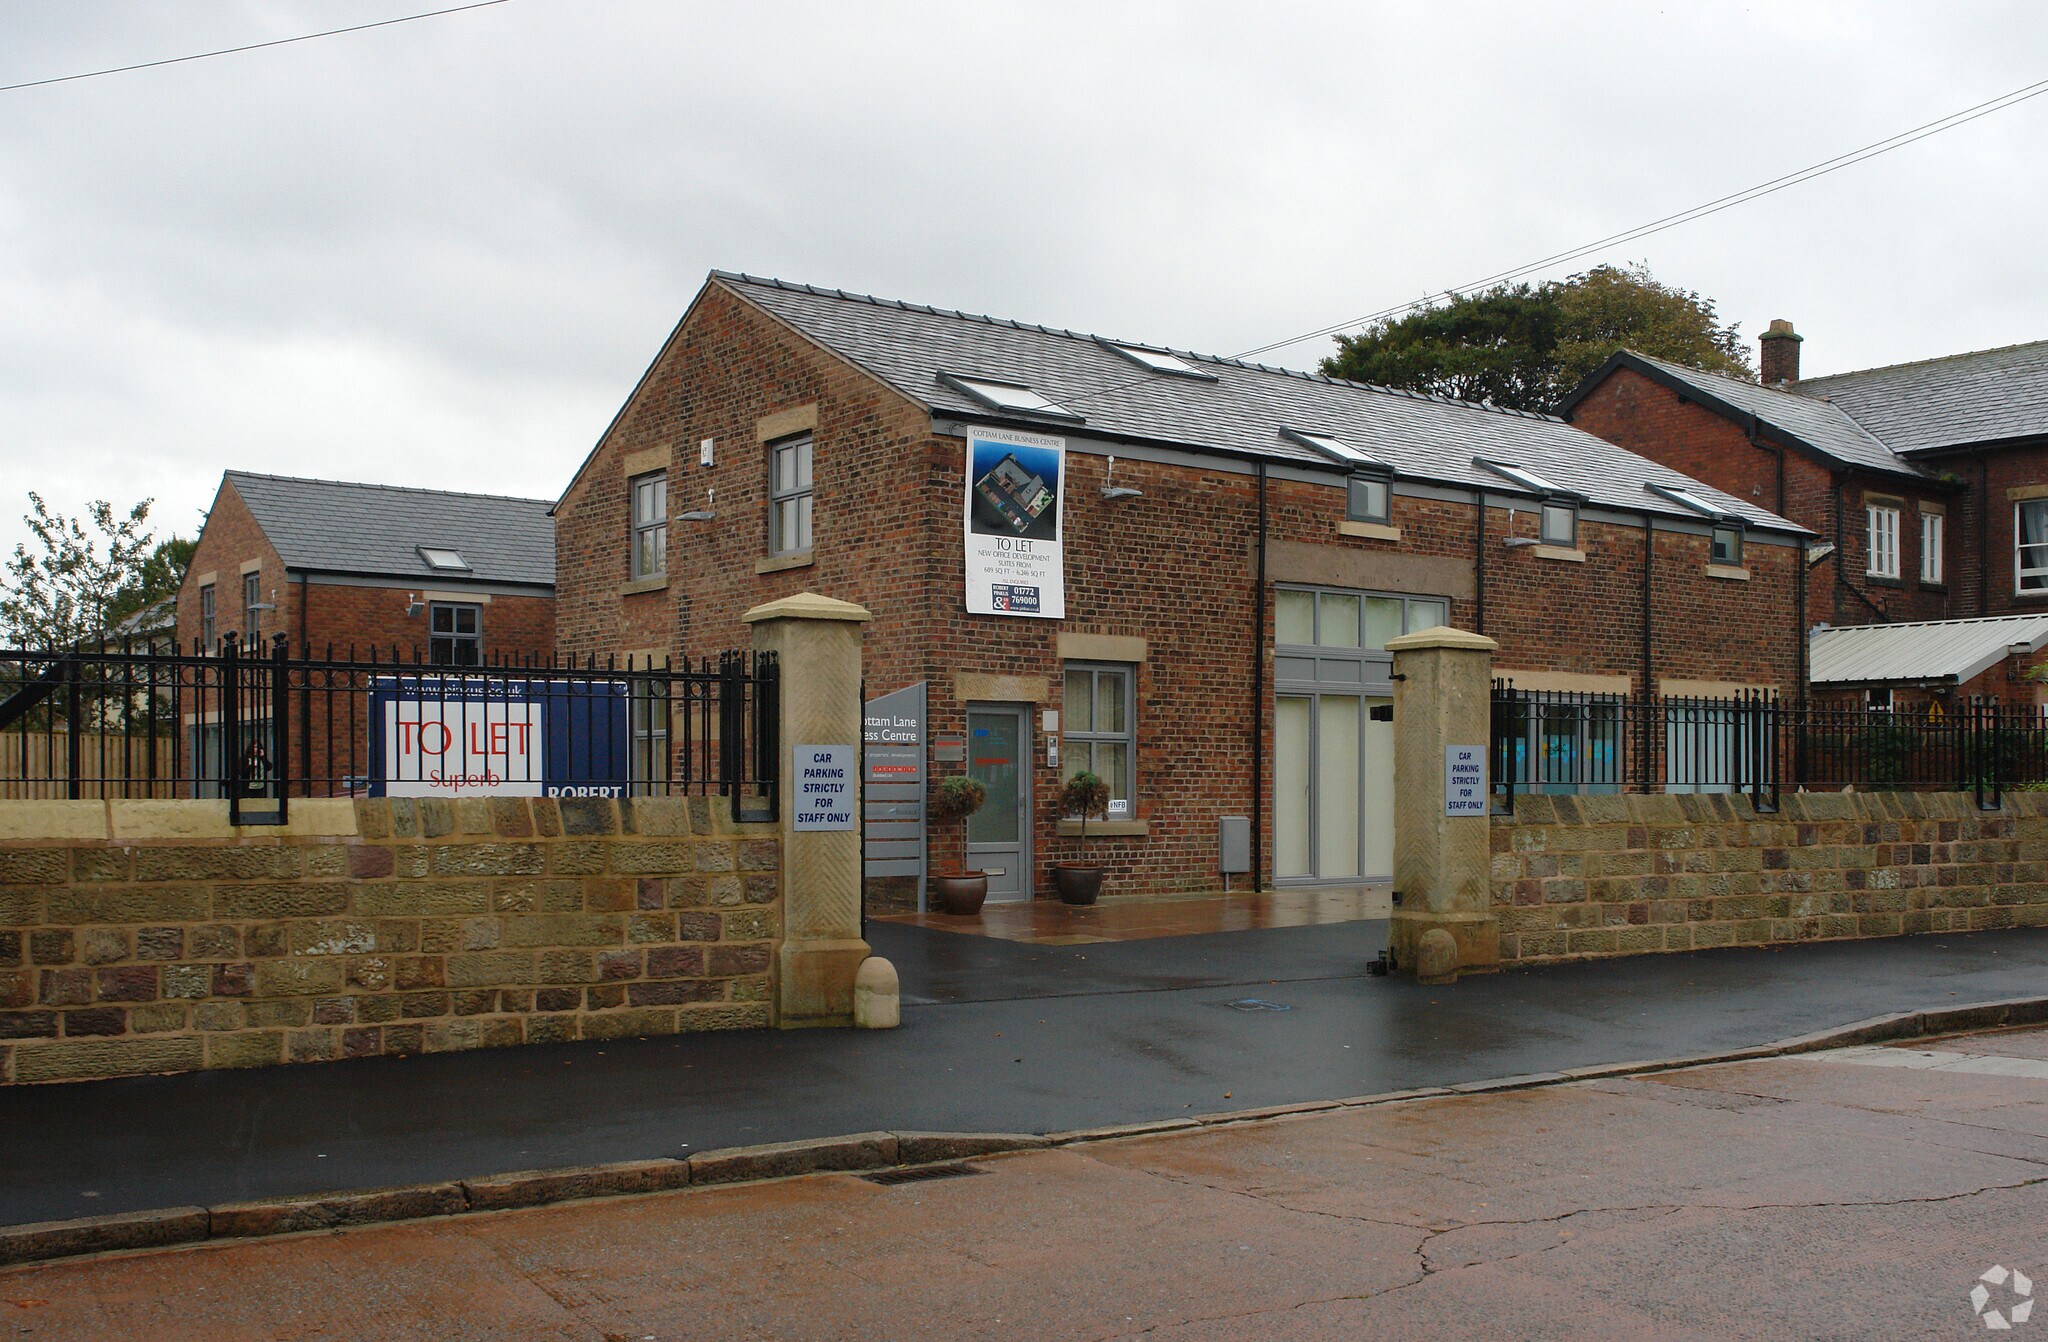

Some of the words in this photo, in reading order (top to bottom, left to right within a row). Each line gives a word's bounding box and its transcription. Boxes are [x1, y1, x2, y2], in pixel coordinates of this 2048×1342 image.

[998, 433, 1013, 441] LANE
[995, 537, 1011, 551] TO
[1015, 540, 1034, 552] LET
[978, 549, 991, 557] NEW
[992, 550, 1010, 559] OFFICE
[1012, 552, 1050, 562] DEVELOPMENT
[1013, 586, 1034, 596] 01772
[993, 596, 1007, 610] &
[1011, 595, 1037, 605] 769000
[893, 715, 917, 727] Lane
[399, 721, 452, 755] TO
[471, 722, 533, 755] LET
[881, 729, 917, 741] Centre
[813, 753, 832, 763] CAR
[1459, 752, 1471, 760] CAR
[803, 768, 844, 778] PARKING
[1452, 764, 1479, 773] PARKING
[430, 769, 500, 792] Superb
[1452, 777, 1480, 785] STRICTLY
[548, 786, 623, 798] ROBERT
[803, 783, 845, 793] STRICTLY
[1460, 789, 1472, 797] FOR
[815, 798, 833, 808] FOR
[1448, 801, 1467, 810] STAFF
[1467, 801, 1484, 810] ONLY
[798, 813, 825, 823] STAFF
[827, 813, 851, 823] ONLY
